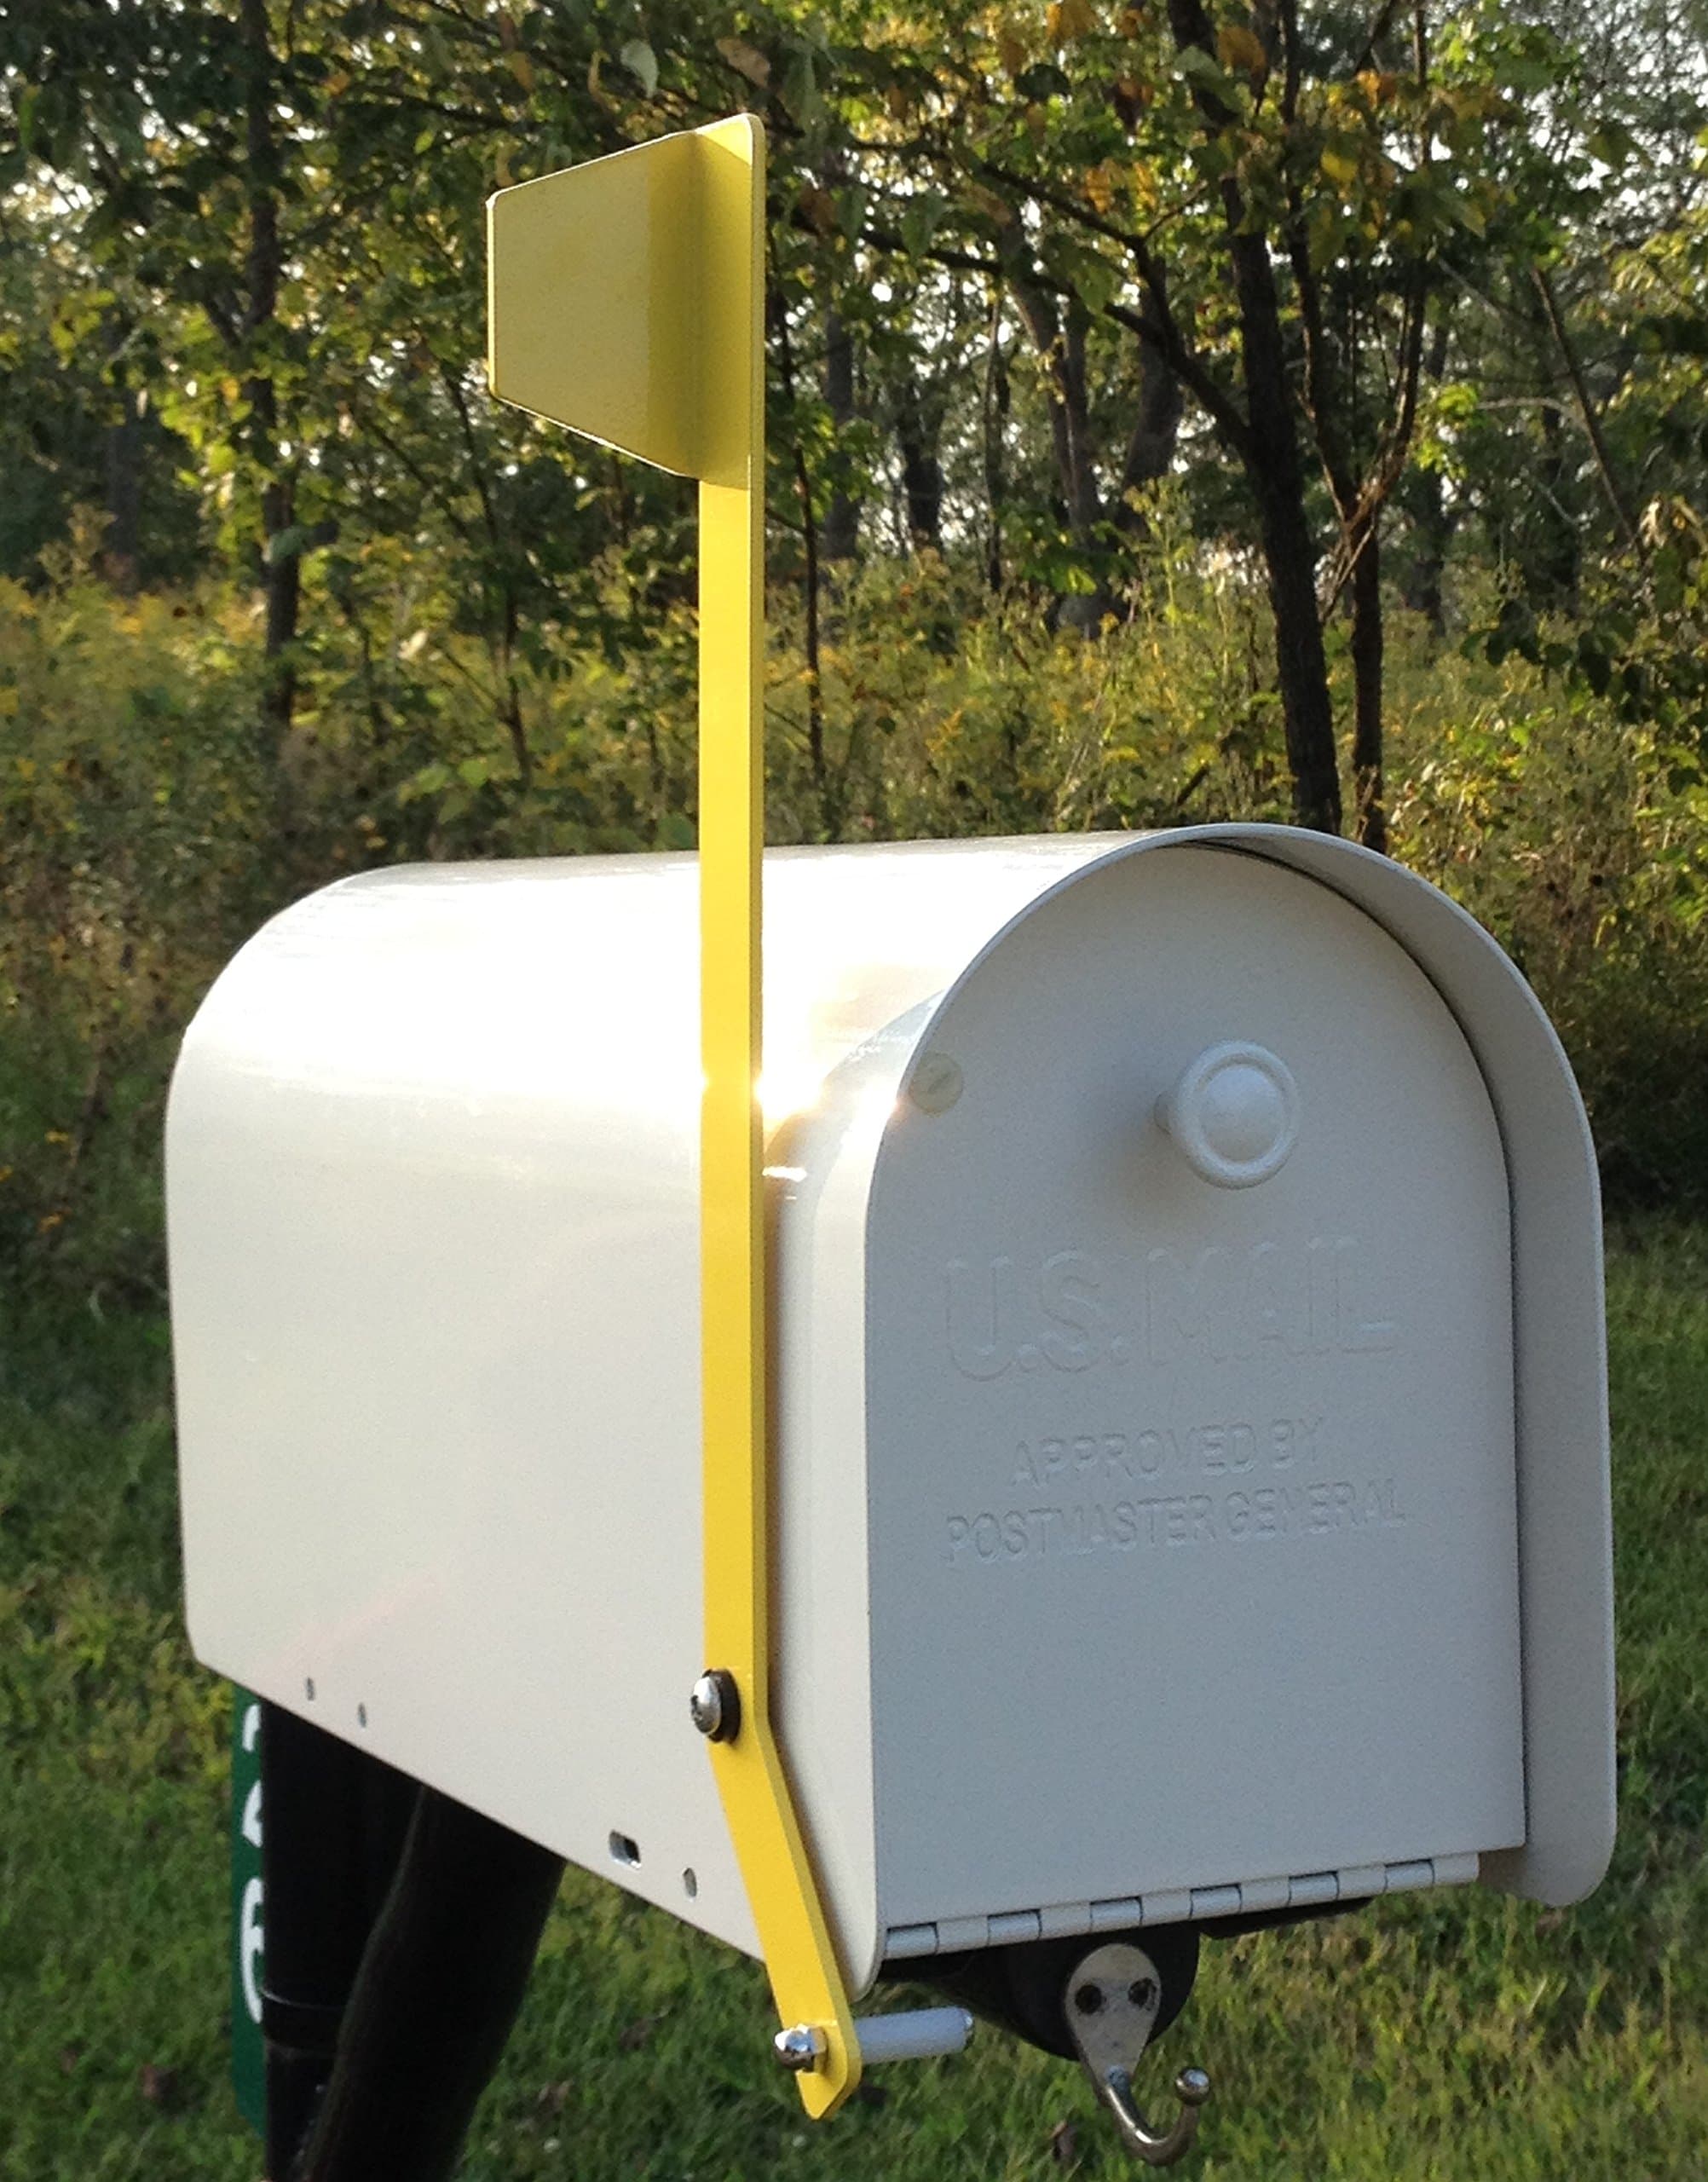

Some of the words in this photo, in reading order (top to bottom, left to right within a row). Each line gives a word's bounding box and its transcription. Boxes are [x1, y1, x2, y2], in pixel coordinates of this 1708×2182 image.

[1012, 1422, 1257, 1488] APPROVED
[1267, 1417, 1324, 1471] BY
[943, 1492, 1219, 1565] POSTMASTER
[1226, 1478, 1407, 1543] GENERAL
